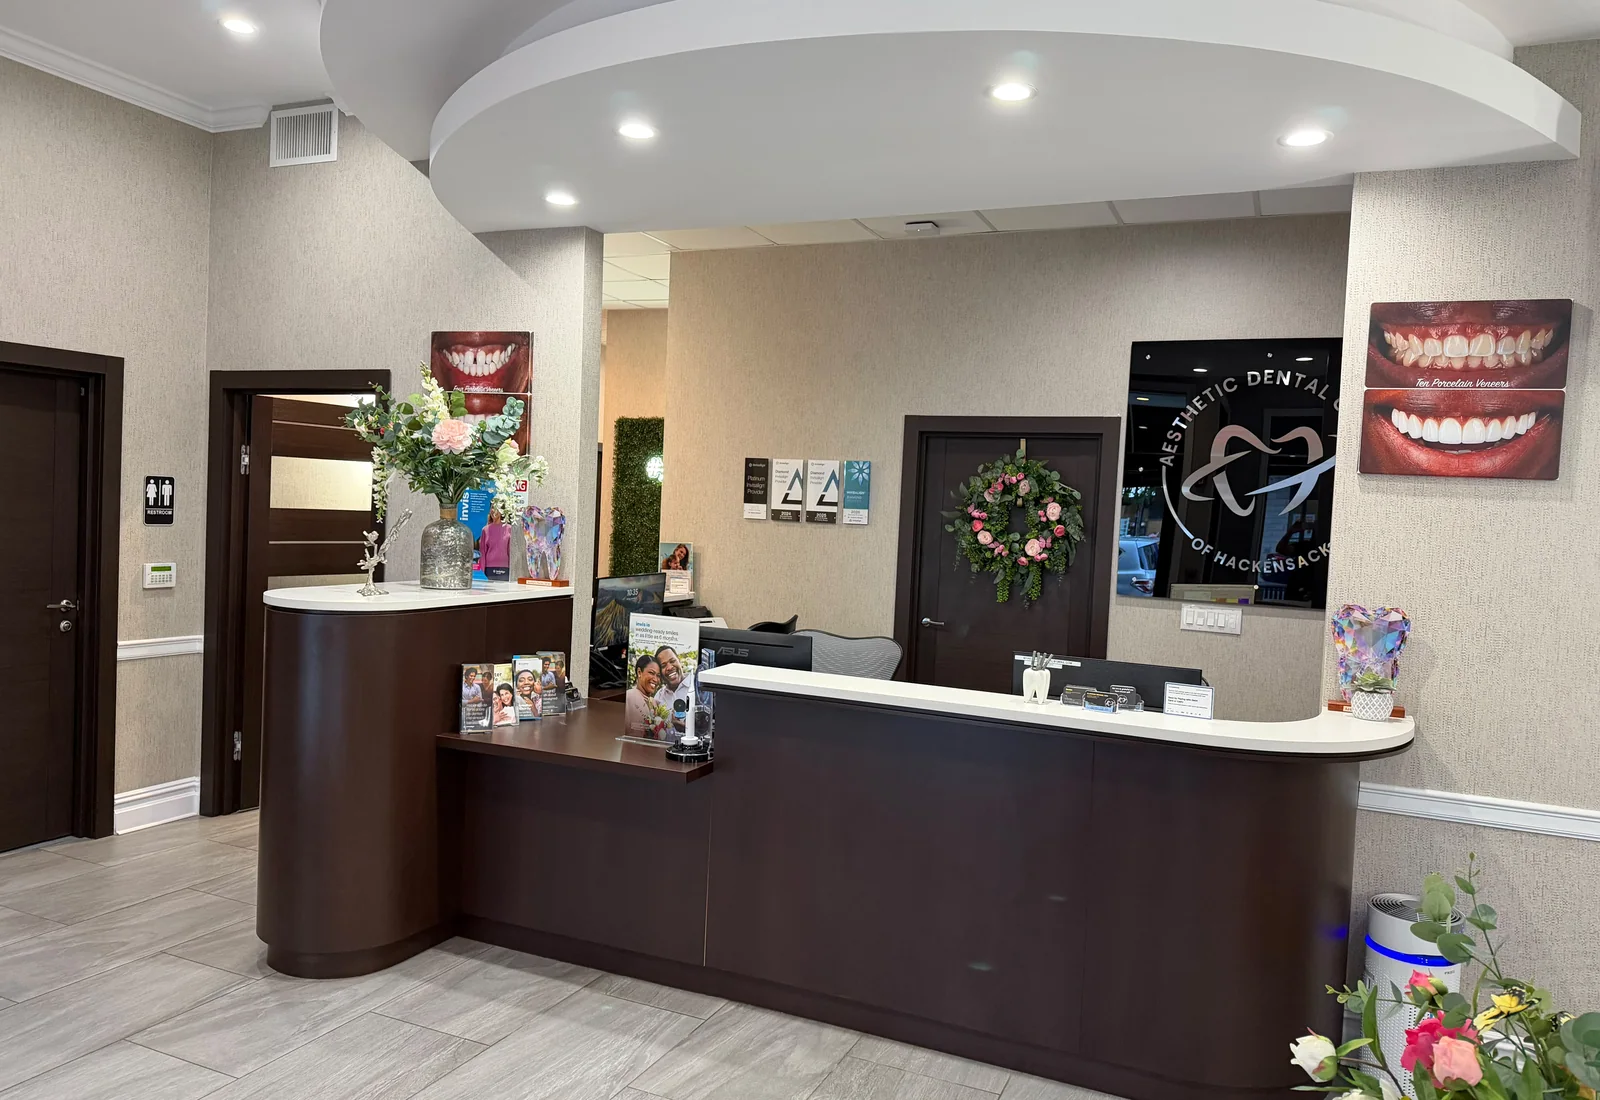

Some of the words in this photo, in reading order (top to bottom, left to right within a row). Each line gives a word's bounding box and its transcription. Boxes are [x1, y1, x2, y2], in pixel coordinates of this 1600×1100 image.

[1415, 378, 1430, 388] Ten
[1431, 378, 1474, 388] Porcelain
[1475, 378, 1510, 388] Veneers
[1159, 377, 1238, 467] AESTHETIC
[1247, 370, 1330, 401] DENTAL
[1191, 538, 1213, 555] OF
[1214, 542, 1331, 574] HACKENSACK
[717, 646, 749, 657] ASUS
